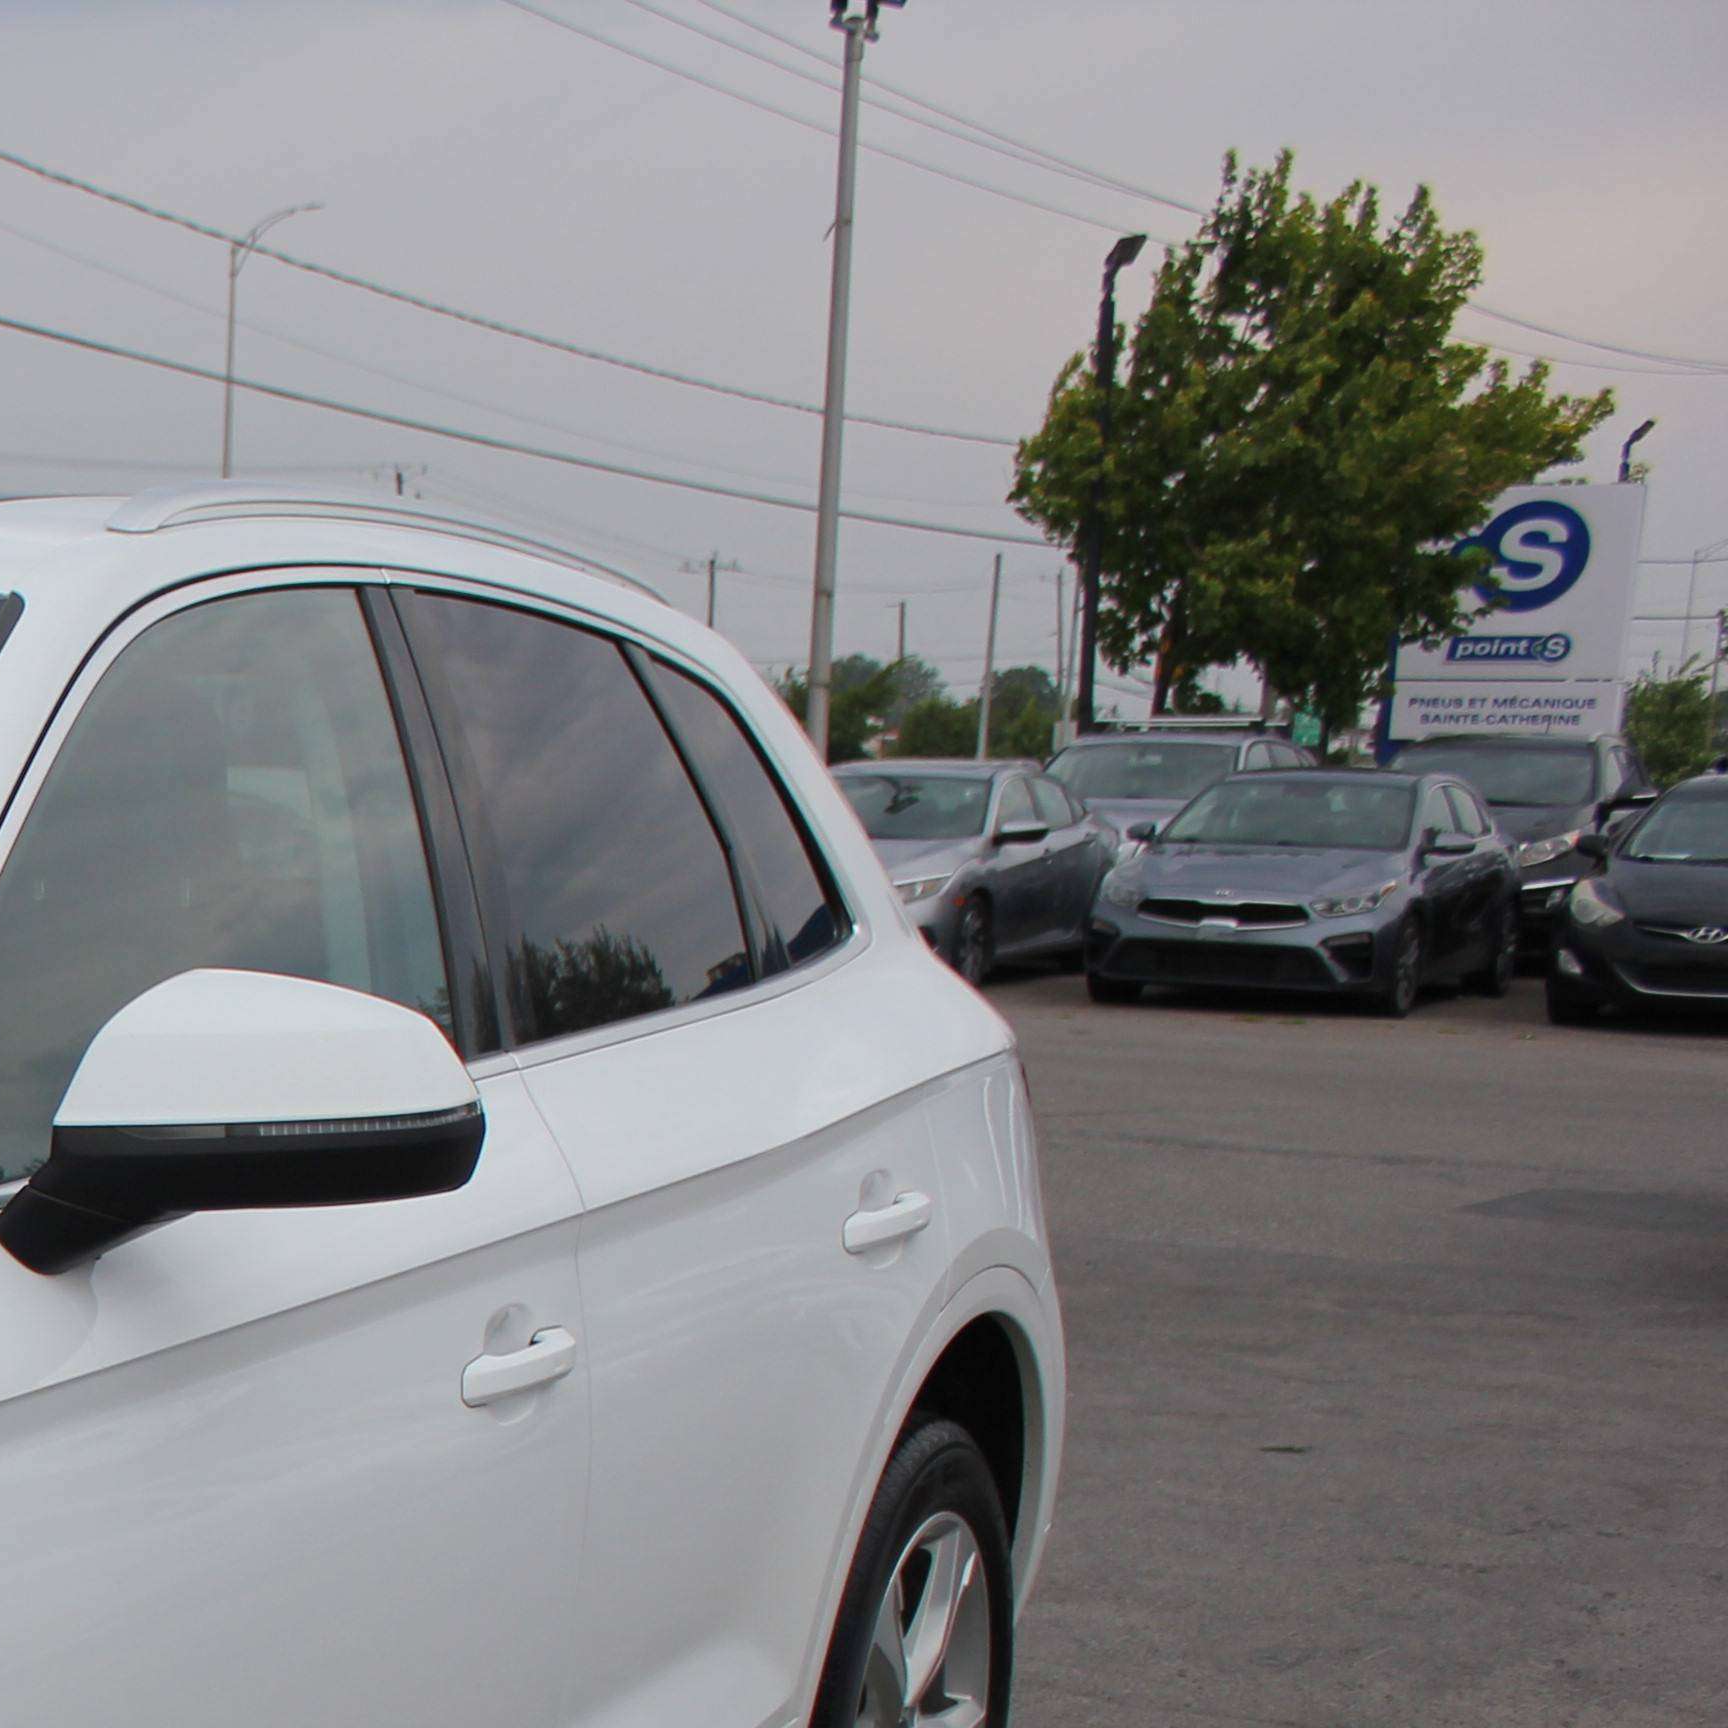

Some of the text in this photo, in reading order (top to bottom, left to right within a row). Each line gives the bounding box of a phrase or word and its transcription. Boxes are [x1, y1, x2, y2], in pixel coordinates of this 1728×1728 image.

[1455, 638, 1529, 658] point
[1408, 695, 1597, 710] PNEUS ET MÉCANIQUE
[1419, 713, 1582, 726] SAINTE-CATHERINE
